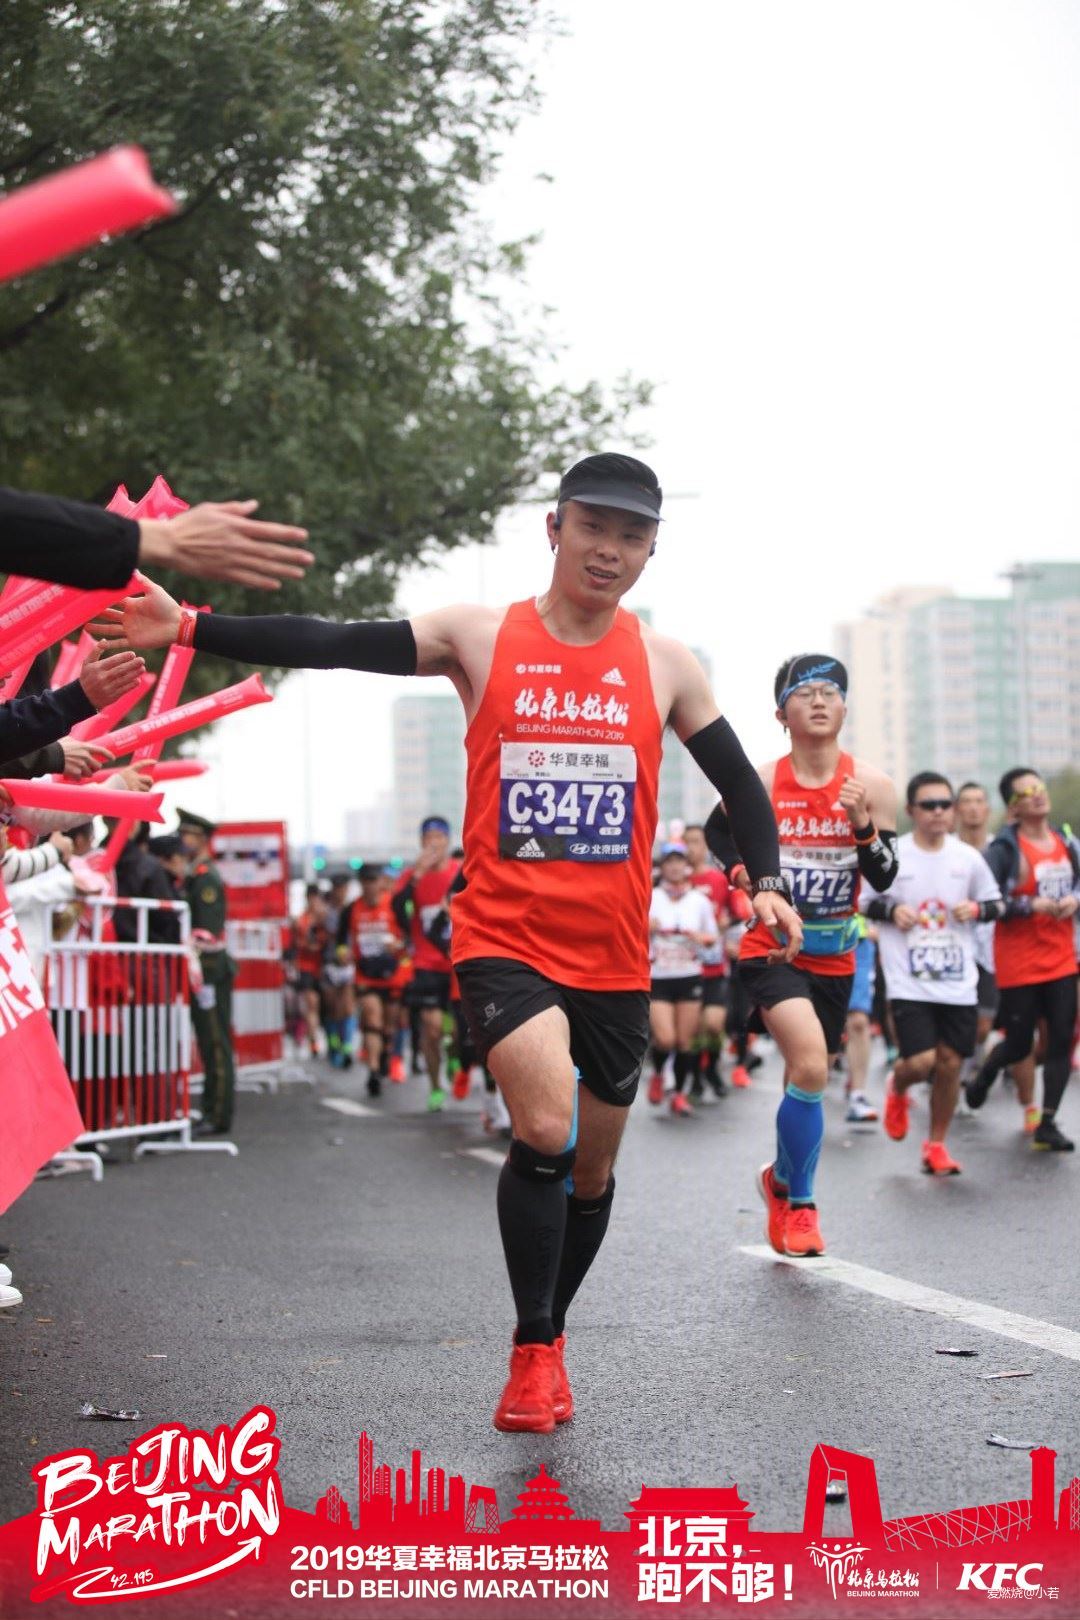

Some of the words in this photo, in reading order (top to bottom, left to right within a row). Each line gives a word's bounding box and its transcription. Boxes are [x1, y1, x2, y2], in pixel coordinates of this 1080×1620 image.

[514, 687, 629, 727] 北京马拉松
[516, 723, 550, 734] BEIJING
[552, 726, 604, 738] MARATHON
[606, 730, 624, 741] 2019
[550, 752, 609, 768] 华夏幸福
[508, 782, 626, 826] C3473
[516, 850, 545, 859] adidas
[591, 844, 628, 856] 北京现代
